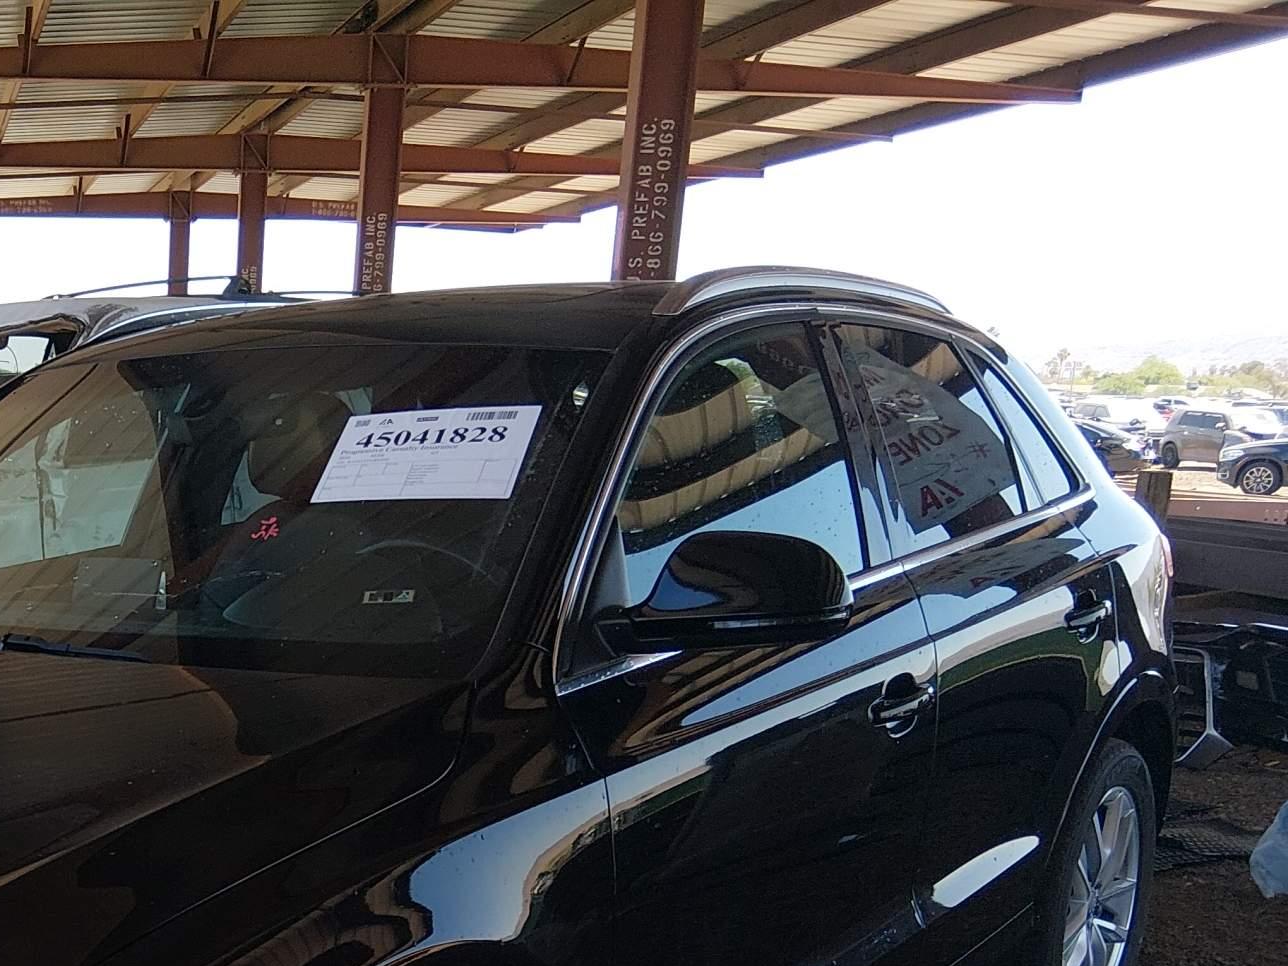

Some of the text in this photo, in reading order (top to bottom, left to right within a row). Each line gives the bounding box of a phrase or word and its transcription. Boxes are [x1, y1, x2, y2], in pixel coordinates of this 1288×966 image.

[640, 117, 658, 153] INC.
[631, 165, 653, 239] PREFAB
[361, 212, 377, 290] PREFAB INC.
[355, 425, 509, 449] 45041828
